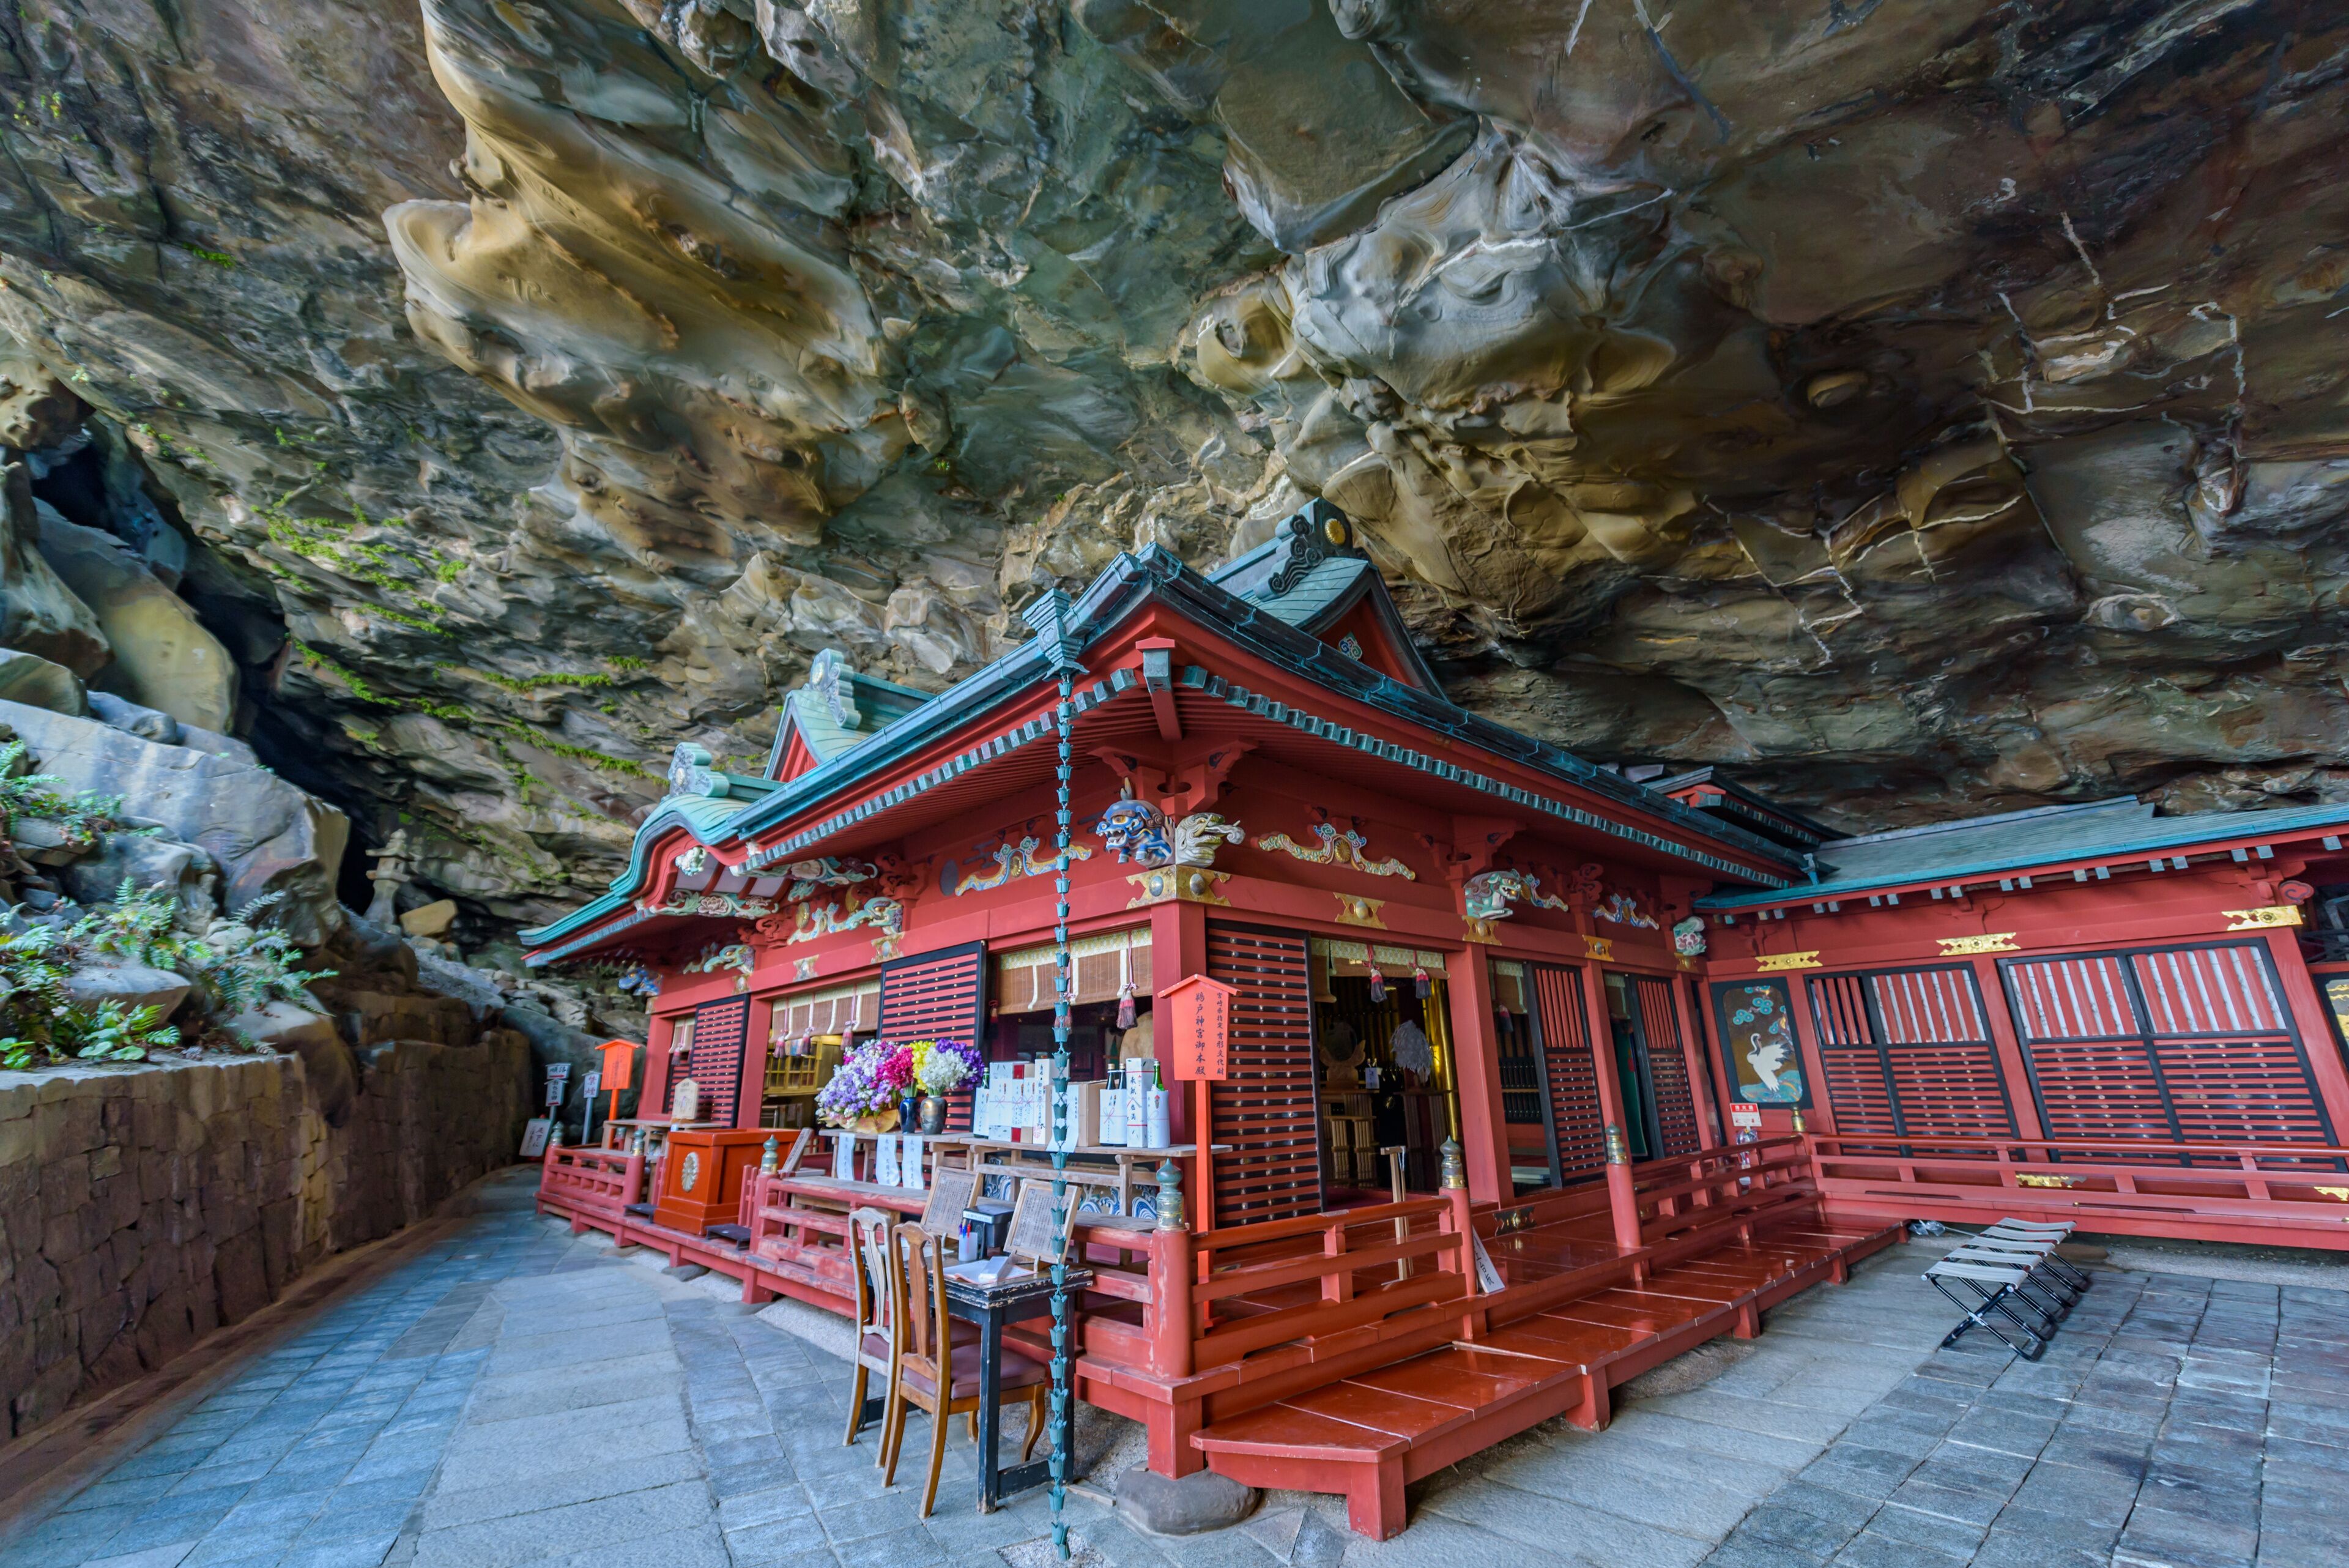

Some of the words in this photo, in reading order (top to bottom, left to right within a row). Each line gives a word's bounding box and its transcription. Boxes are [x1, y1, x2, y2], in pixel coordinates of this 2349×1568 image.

[1195, 992, 1206, 1076] 鵜戸神宮御本殿
[584, 1076, 597, 1096] 禁煙
